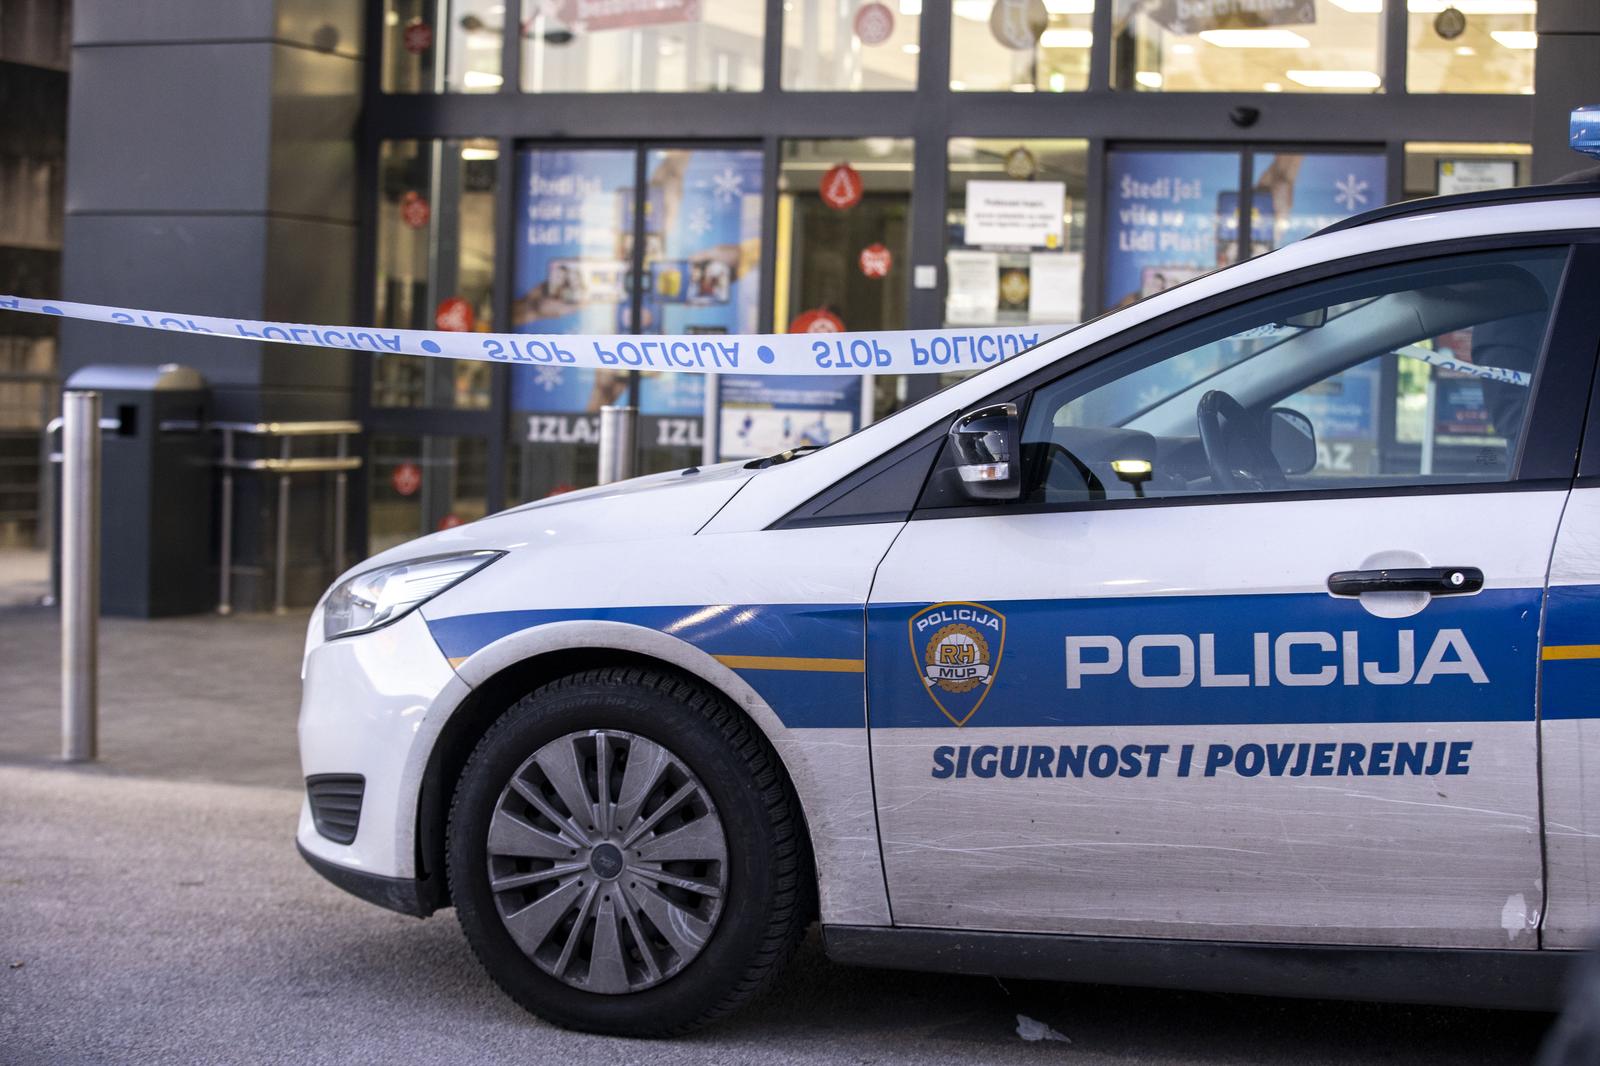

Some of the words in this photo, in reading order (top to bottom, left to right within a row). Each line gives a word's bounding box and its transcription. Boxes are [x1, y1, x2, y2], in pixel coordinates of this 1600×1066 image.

[916, 609, 1000, 632] POLICIJA
[939, 644, 976, 665] RH
[1065, 628, 1490, 690] POLICIJA
[939, 667, 977, 678] MUP
[931, 744, 1169, 779] SIGURNOST
[1177, 744, 1195, 778] I
[1204, 741, 1474, 778] POVJERENJE
